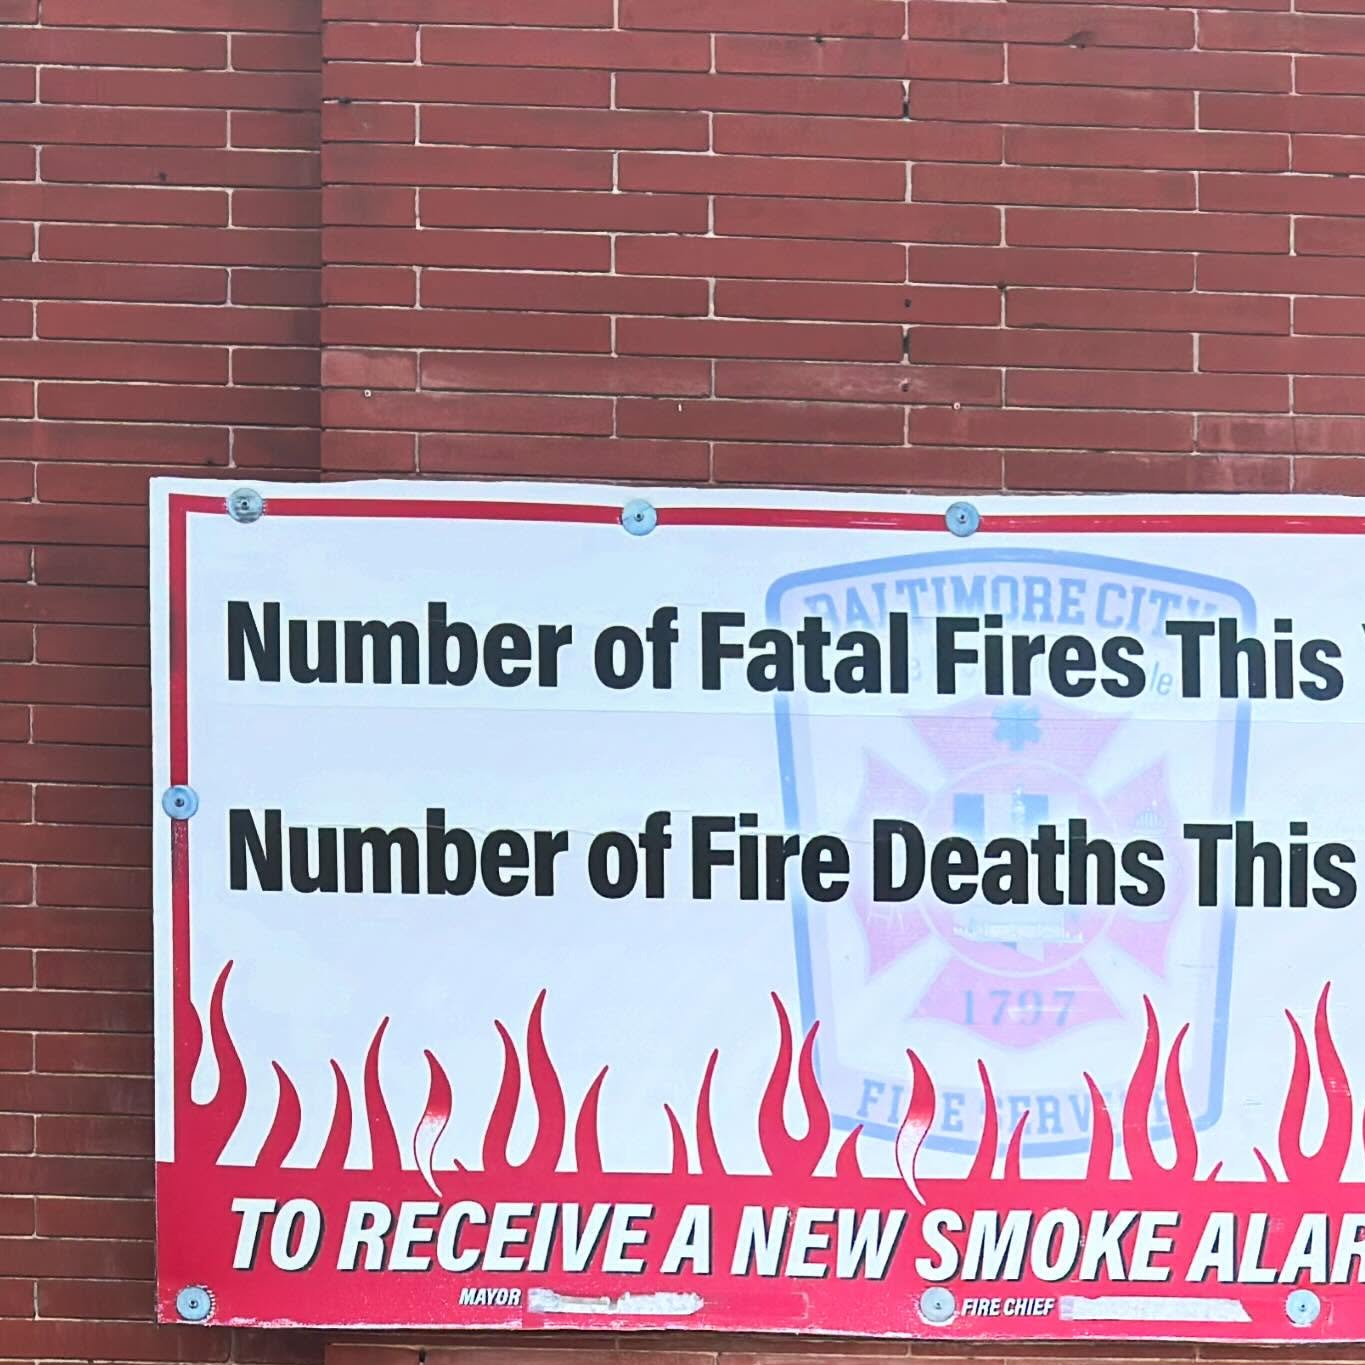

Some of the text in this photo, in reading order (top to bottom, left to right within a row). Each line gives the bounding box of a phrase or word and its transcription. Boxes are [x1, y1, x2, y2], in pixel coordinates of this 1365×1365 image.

[1100, 583, 1220, 638] CIT
[227, 600, 573, 688] Number
[594, 606, 679, 690] of
[701, 611, 909, 694] Fatal
[935, 613, 1146, 698] Fires
[1165, 617, 1344, 701] This
[229, 807, 569, 897] Number
[587, 810, 672, 900] of
[691, 812, 850, 903] Fire
[873, 818, 1166, 907] Deaths
[1183, 820, 1358, 910] This
[963, 989, 1076, 1027] 1797
[856, 1078, 966, 1133] FIE
[231, 1198, 321, 1272] TO
[336, 1200, 654, 1274] RECEIVE
[659, 1204, 714, 1275] A
[730, 1205, 907, 1280] NEW
[915, 1207, 1180, 1283] SMOKE
[458, 1287, 522, 1307] MAYOR
[961, 1296, 1055, 1317] FIRE CHIEF
